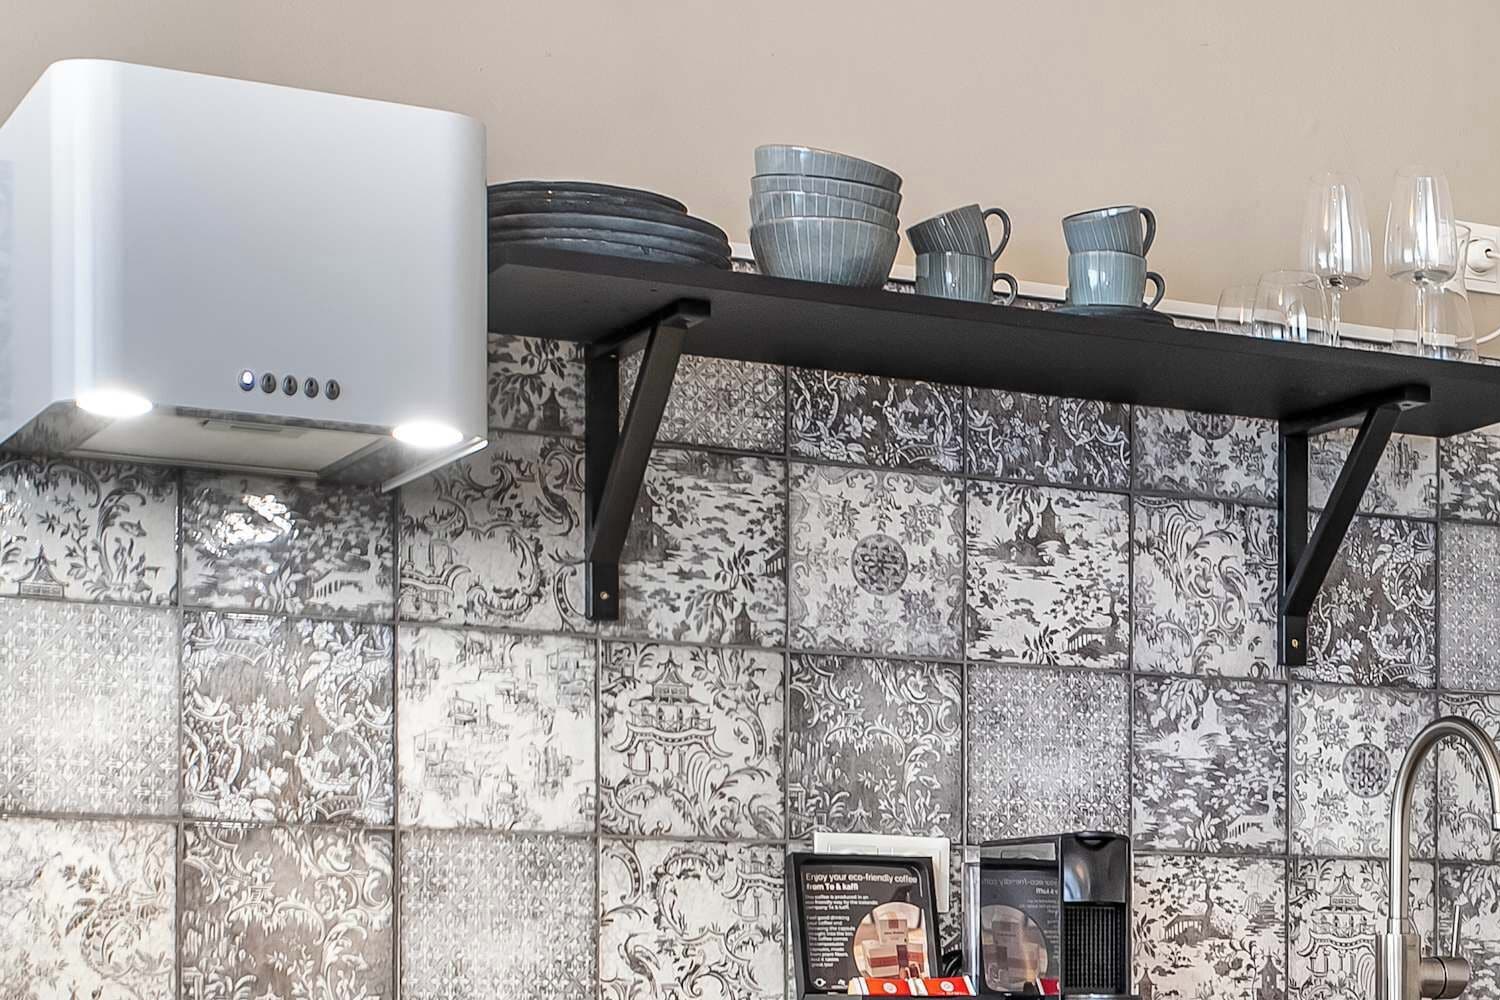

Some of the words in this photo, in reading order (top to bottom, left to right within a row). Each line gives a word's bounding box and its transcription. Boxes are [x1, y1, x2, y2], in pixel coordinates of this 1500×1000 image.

[805, 872, 828, 882] Enjoy
[829, 873, 848, 882] your
[848, 872, 893, 883] eco-friendly
[894, 875, 918, 883] coffee
